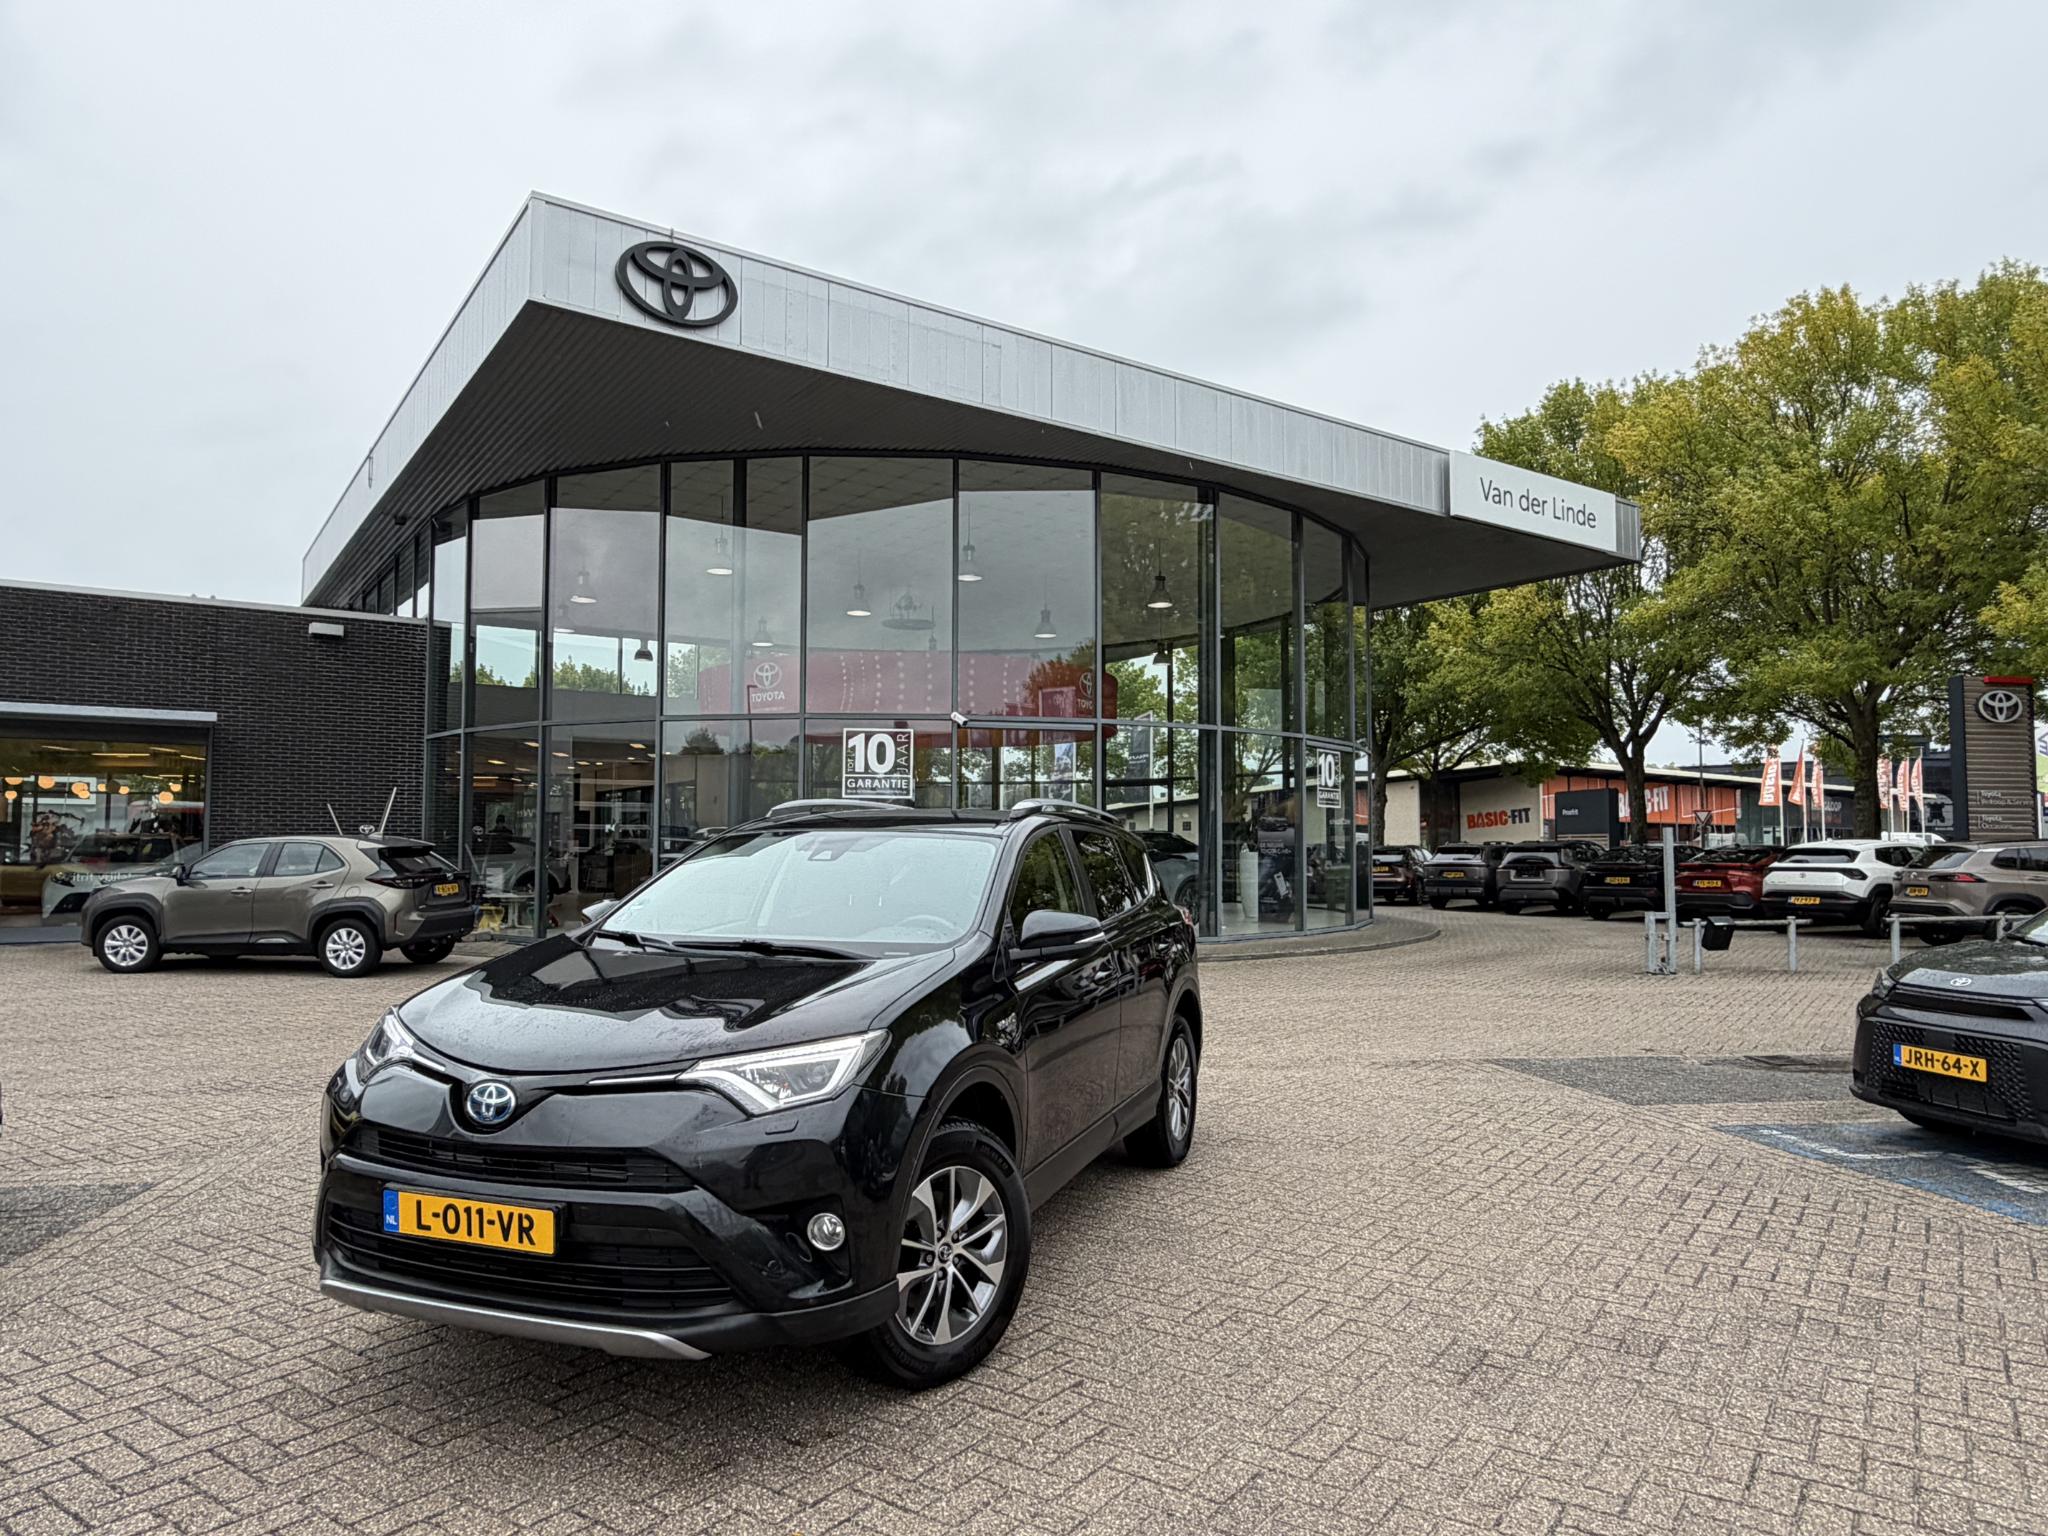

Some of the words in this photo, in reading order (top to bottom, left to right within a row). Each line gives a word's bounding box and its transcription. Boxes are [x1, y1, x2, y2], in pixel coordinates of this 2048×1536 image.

[1480, 477, 1513, 507] Van
[1519, 488, 1547, 516] der
[1553, 496, 1597, 528] Linde
[751, 690, 785, 702] TOYOTA
[847, 732, 896, 774] 10
[896, 733, 909, 774] JAAR
[1318, 752, 1335, 787] 10
[847, 778, 909, 789] GARANTIE
[1319, 791, 1340, 801] GARANTIE
[1981, 790, 2002, 799] Toyota
[1618, 785, 1669, 818] BAC-FIT
[1467, 807, 1531, 829] BASIC-FIT
[1982, 814, 2003, 823] Toyota
[1905, 1048, 1980, 1078] JRH-64-X
[385, 1213, 398, 1226] NL
[416, 1199, 536, 1246] L-011-VR
